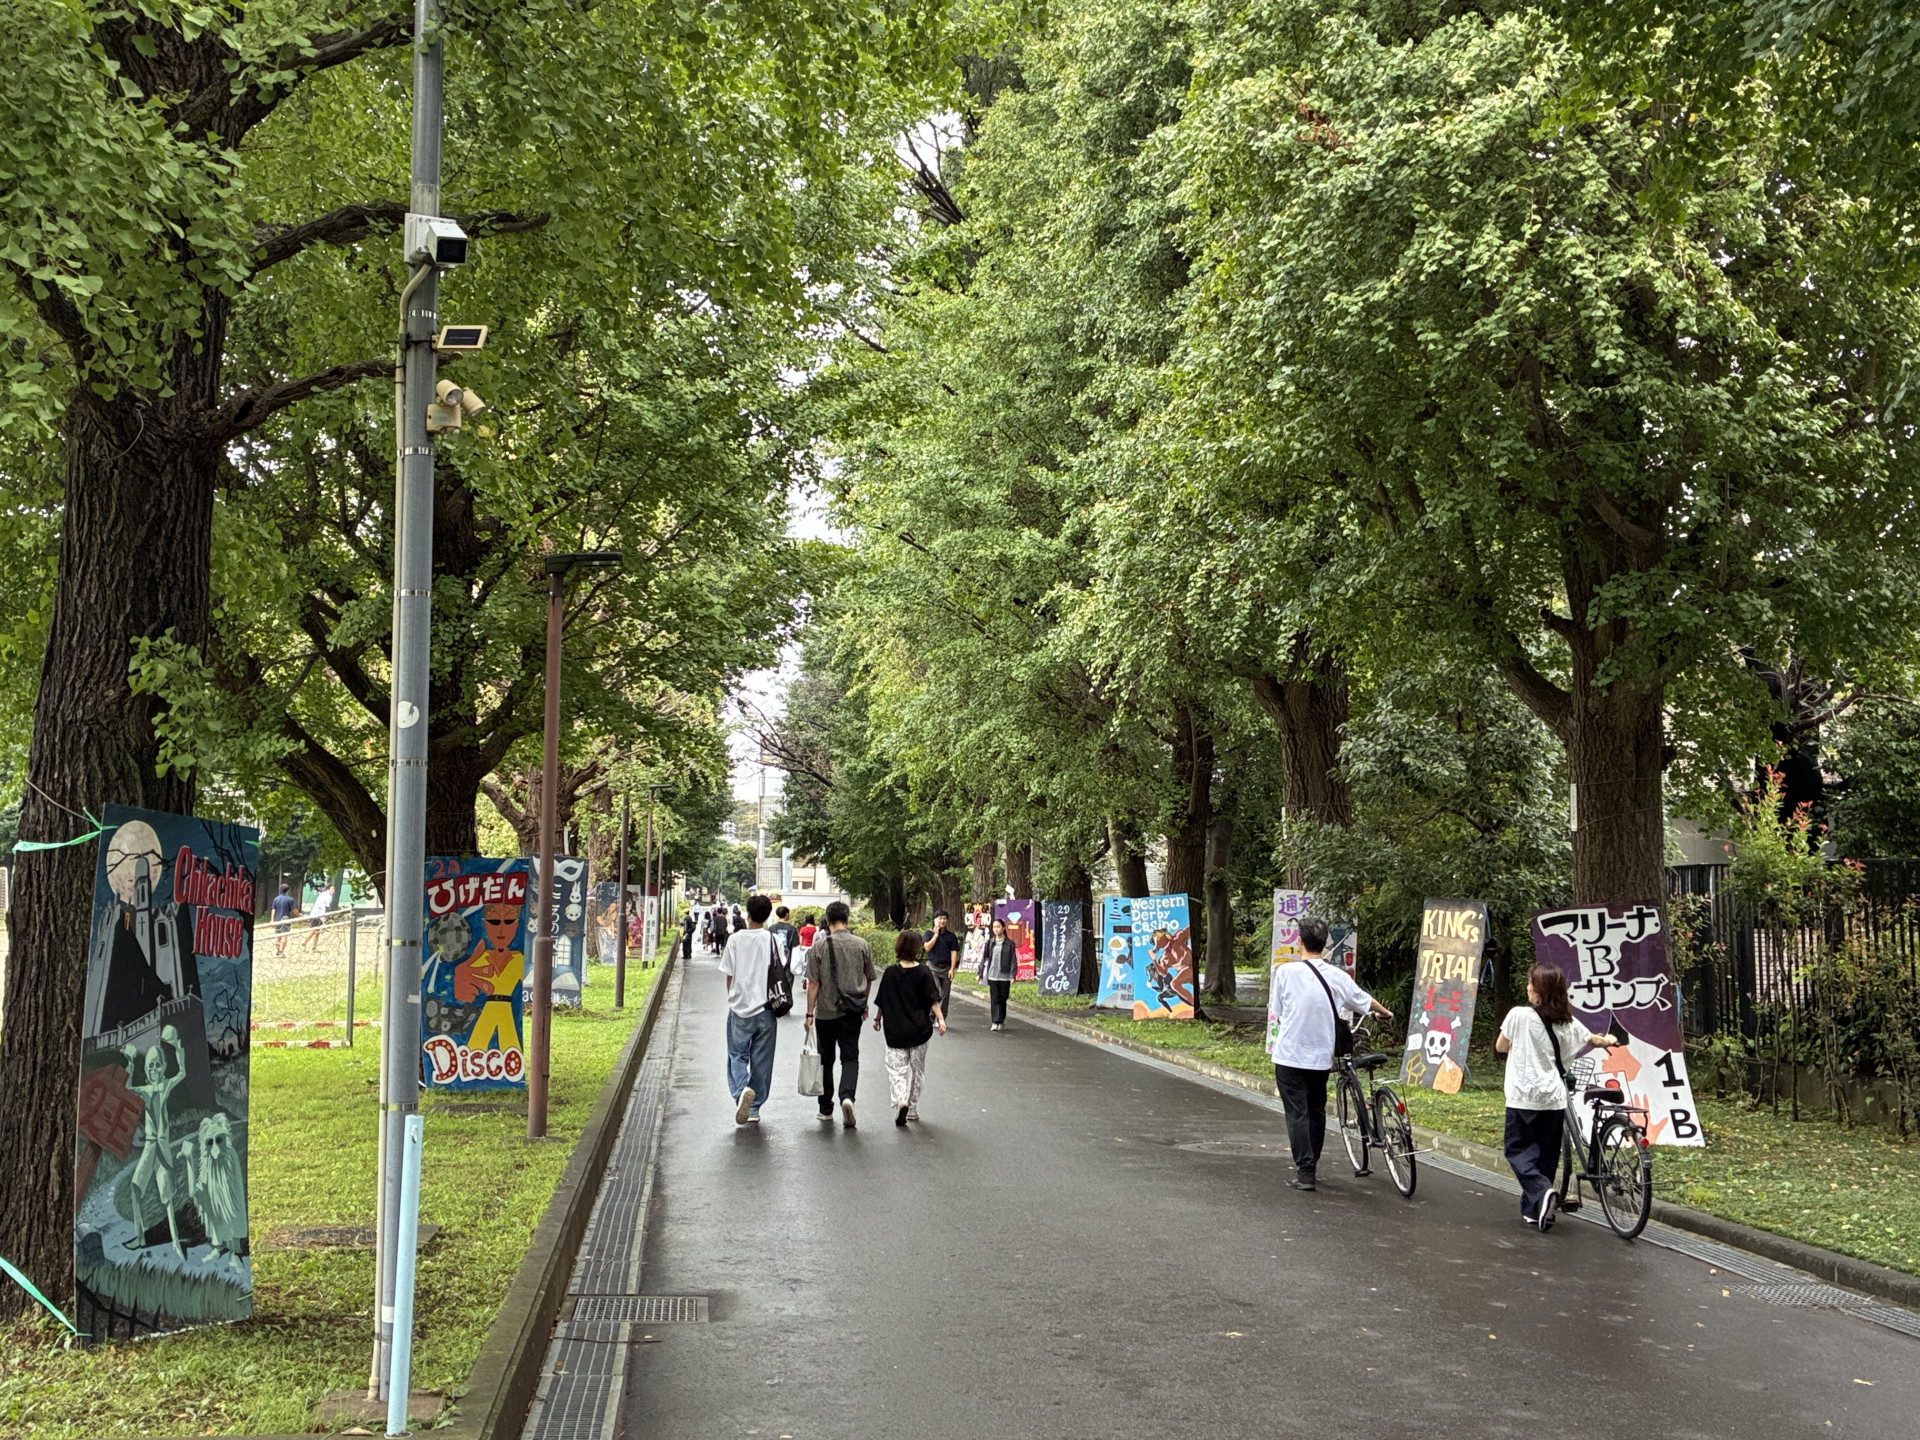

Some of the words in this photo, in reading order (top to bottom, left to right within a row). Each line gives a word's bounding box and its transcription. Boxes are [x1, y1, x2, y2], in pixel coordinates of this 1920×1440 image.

[173, 845, 254, 914] Chikachika
[431, 859, 461, 878] 2A
[427, 874, 525, 914] ひげだん
[1130, 896, 1186, 910] Western
[1131, 909, 1171, 921] Derby
[1131, 919, 1180, 934] Casino
[192, 905, 244, 960] House
[1133, 934, 1151, 947] 2F
[1421, 949, 1479, 984] TRIAL
[1586, 945, 1615, 977] B
[1045, 975, 1070, 992] Cafe
[1423, 986, 1462, 1012] 1-E
[424, 1036, 524, 1083] Disco
